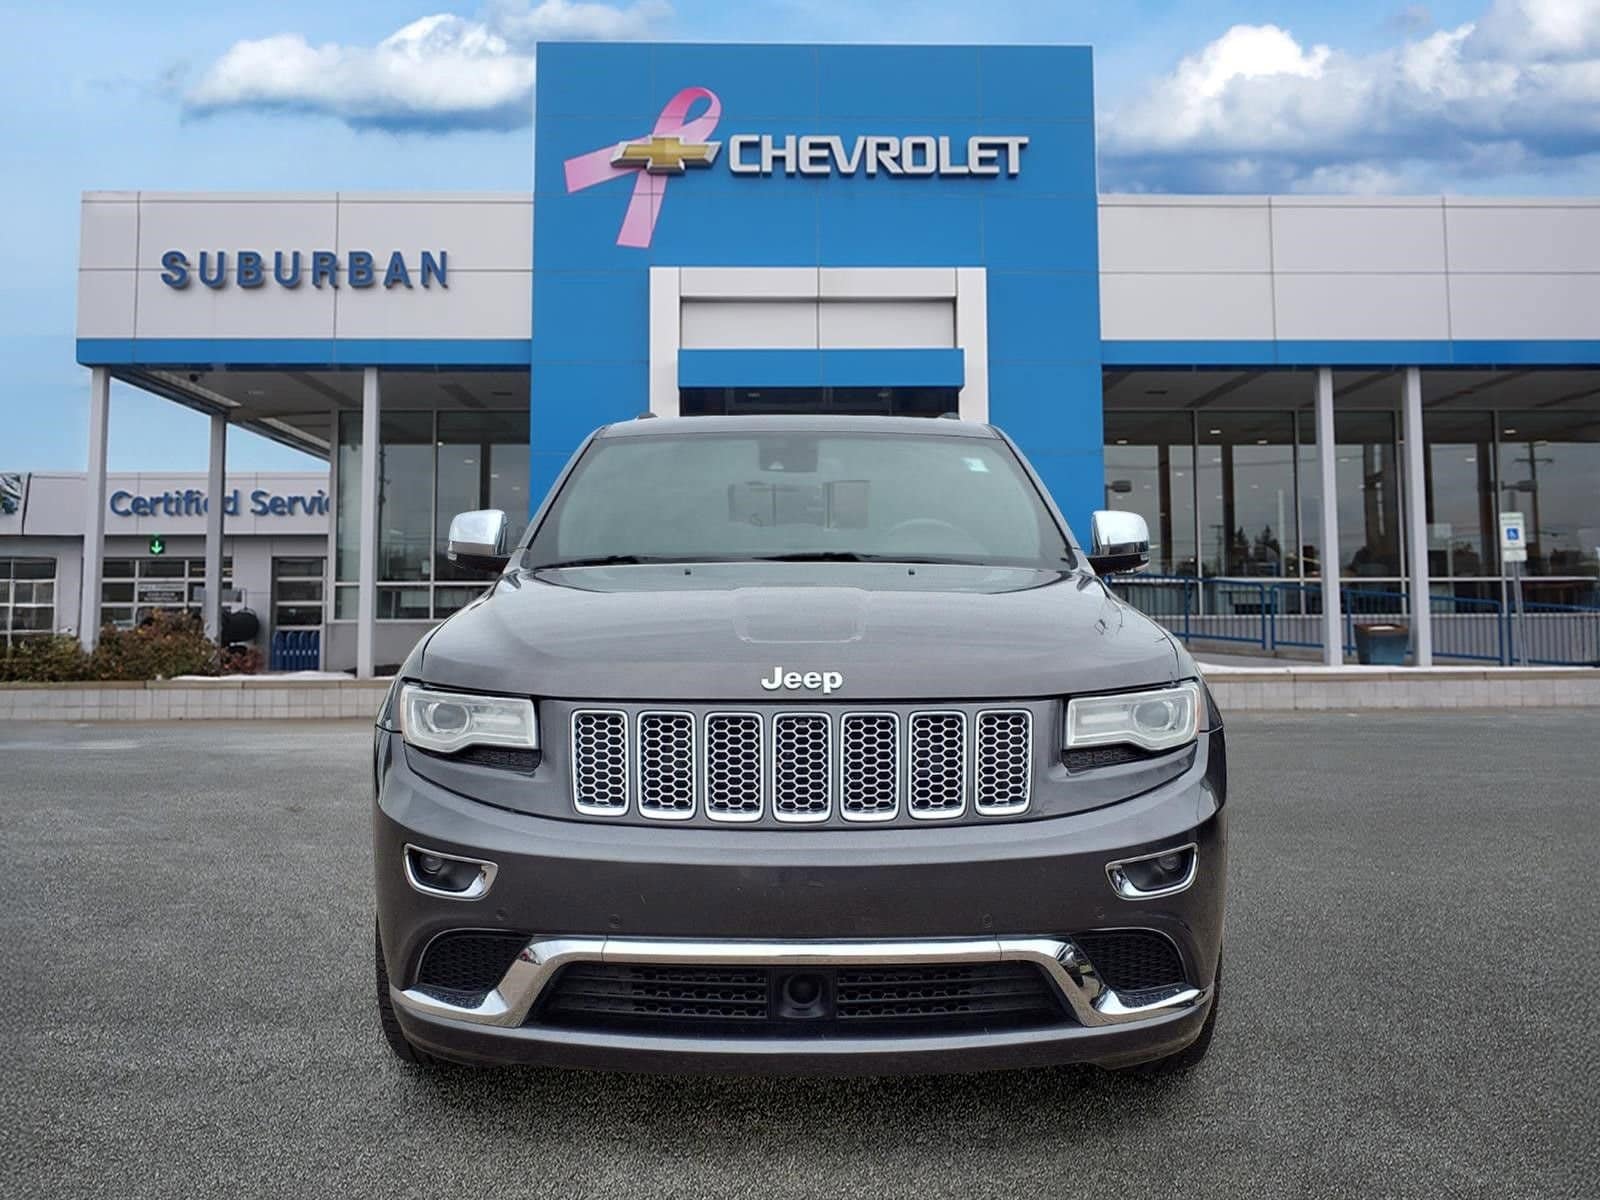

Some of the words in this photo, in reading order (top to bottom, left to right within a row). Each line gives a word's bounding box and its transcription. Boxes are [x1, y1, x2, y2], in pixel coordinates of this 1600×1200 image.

[729, 134, 1029, 177] CHEVROLET
[161, 250, 449, 289] SUBURBAN
[110, 489, 239, 516] Certifid
[760, 666, 843, 694] Jeep
